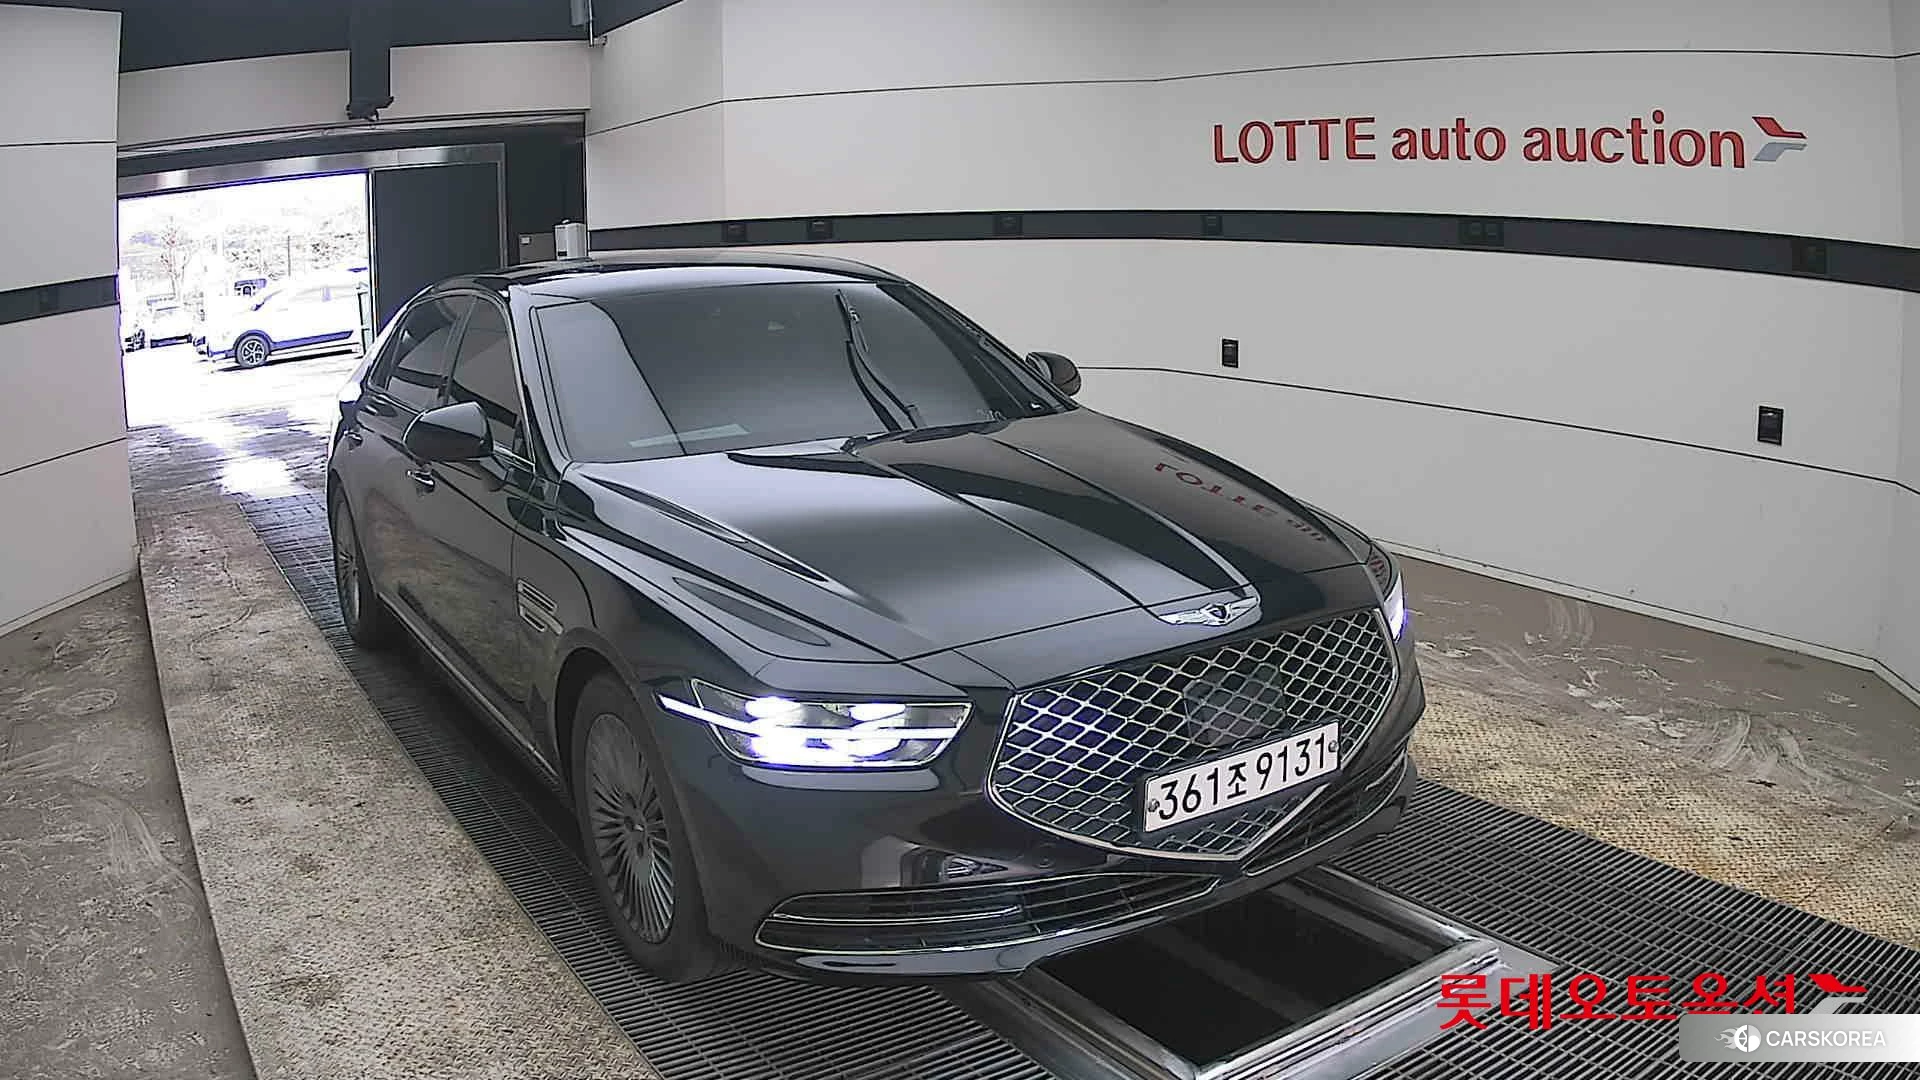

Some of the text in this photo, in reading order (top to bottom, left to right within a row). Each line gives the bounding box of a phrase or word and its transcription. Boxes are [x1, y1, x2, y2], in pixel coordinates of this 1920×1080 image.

[1213, 110, 1746, 169] LOTTE auto auction
